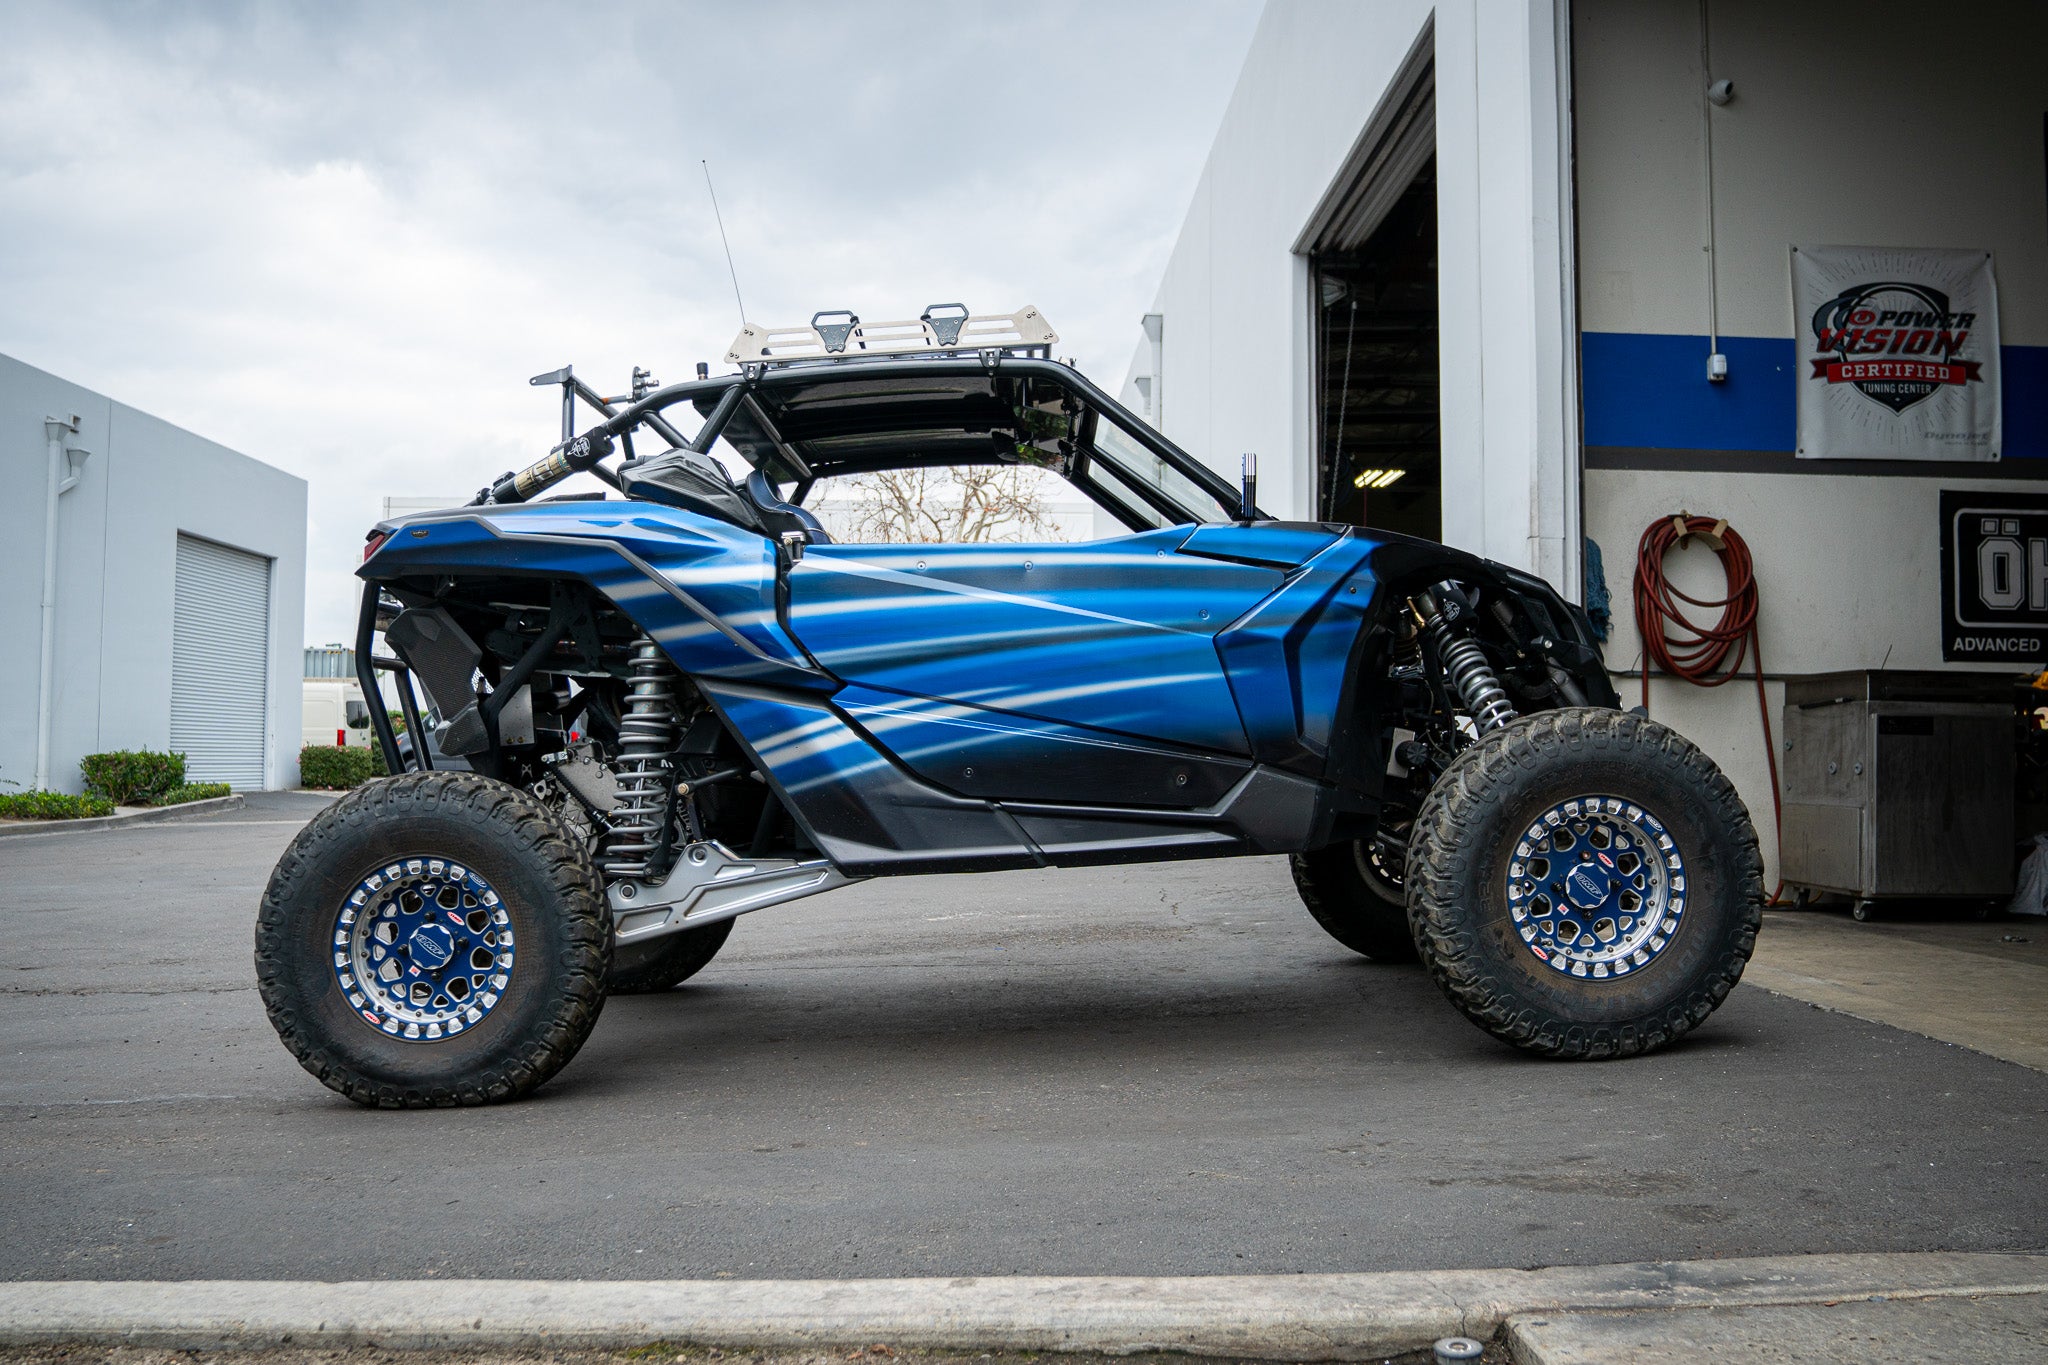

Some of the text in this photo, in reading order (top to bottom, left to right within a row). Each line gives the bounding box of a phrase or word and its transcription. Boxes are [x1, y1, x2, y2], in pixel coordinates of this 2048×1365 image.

[1877, 310, 1976, 329] POWER
[1816, 327, 1969, 356] VISION
[1841, 364, 1950, 380] CERTIFIED
[1862, 383, 1932, 394] TUNING CENTER
[1953, 637, 2041, 652] ADVANCED
